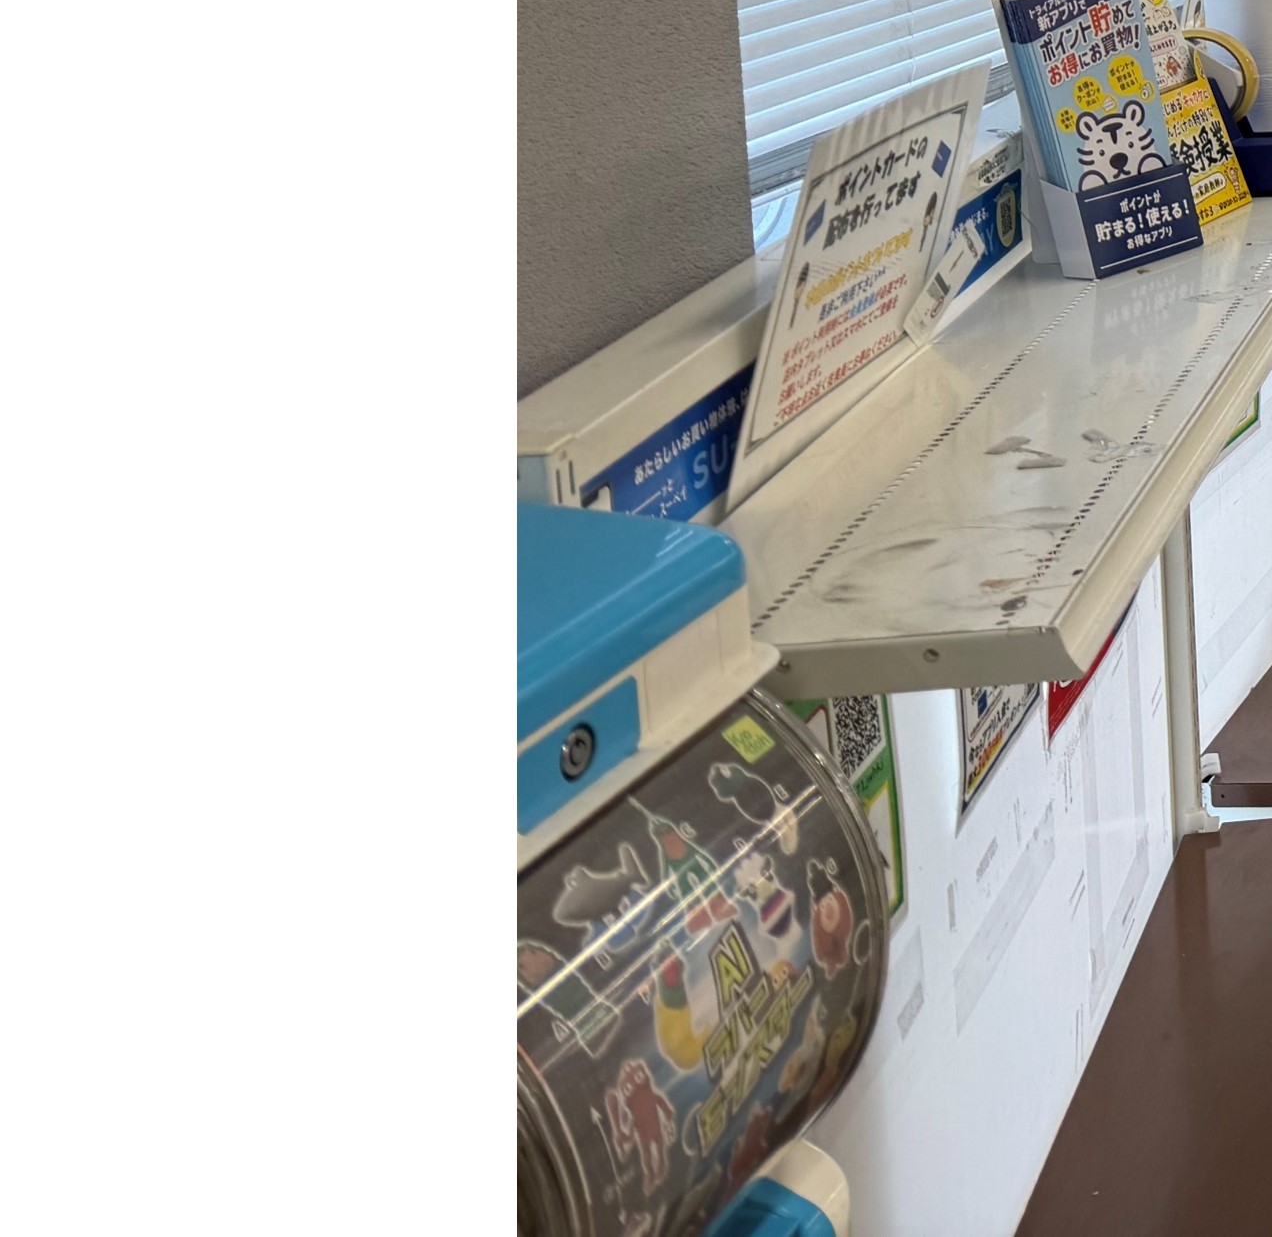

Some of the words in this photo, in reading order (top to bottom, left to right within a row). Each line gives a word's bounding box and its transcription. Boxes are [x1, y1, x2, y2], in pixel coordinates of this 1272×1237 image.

[1119, 189, 1163, 213] ポイントが
[1126, 225, 1173, 250] お得なアプリ
